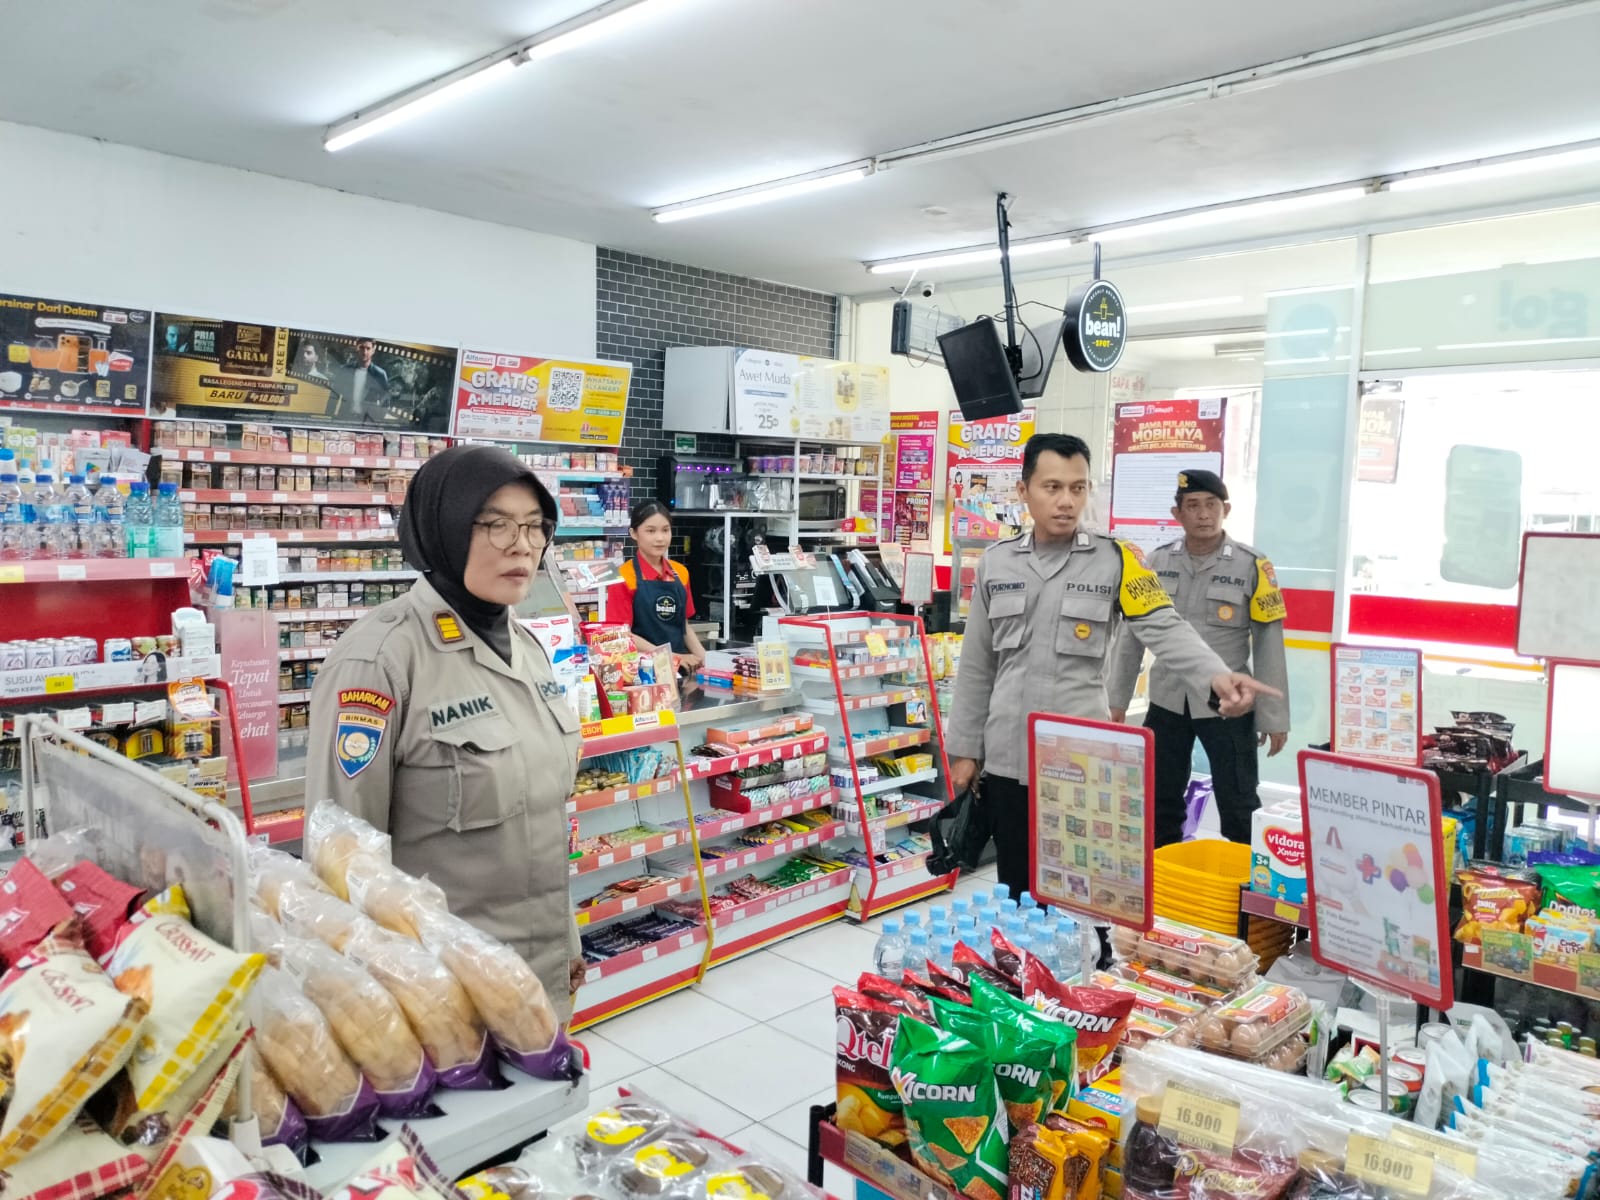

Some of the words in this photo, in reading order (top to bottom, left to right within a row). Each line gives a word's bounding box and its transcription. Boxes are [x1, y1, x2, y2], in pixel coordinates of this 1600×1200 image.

[37, 301, 61, 313] Dari
[63, 305, 98, 318] Dalam
[1085, 313, 1121, 338] bean!
[226, 350, 268, 362] GARAM
[276, 327, 287, 374] KRETEK
[471, 370, 540, 394] GRATIS
[739, 369, 762, 382] Awet
[764, 371, 791, 385] Muda
[210, 389, 243, 400] BARU
[960, 422, 1022, 442] GRATIS
[1132, 428, 1204, 443] MOBILNYA
[906, 497, 929, 506] PROMO
[1066, 582, 1112, 595] POLISI
[1212, 575, 1246, 587] POLRI
[5, 676, 33, 686] SUSU
[231, 669, 270, 689] Tepat
[341, 691, 390, 711] BAHARKAM
[345, 714, 379, 725] BINMAS
[431, 696, 493, 727] NANIK
[236, 722, 269, 739] ehat
[1310, 785, 1369, 813] MEMBER
[1372, 799, 1427, 827] PINTAR
[1267, 834, 1305, 850] vidora
[1549, 901, 1597, 918] Doritos
[1176, 1105, 1222, 1133] 16.900
[1363, 1151, 1413, 1180] 16.900
